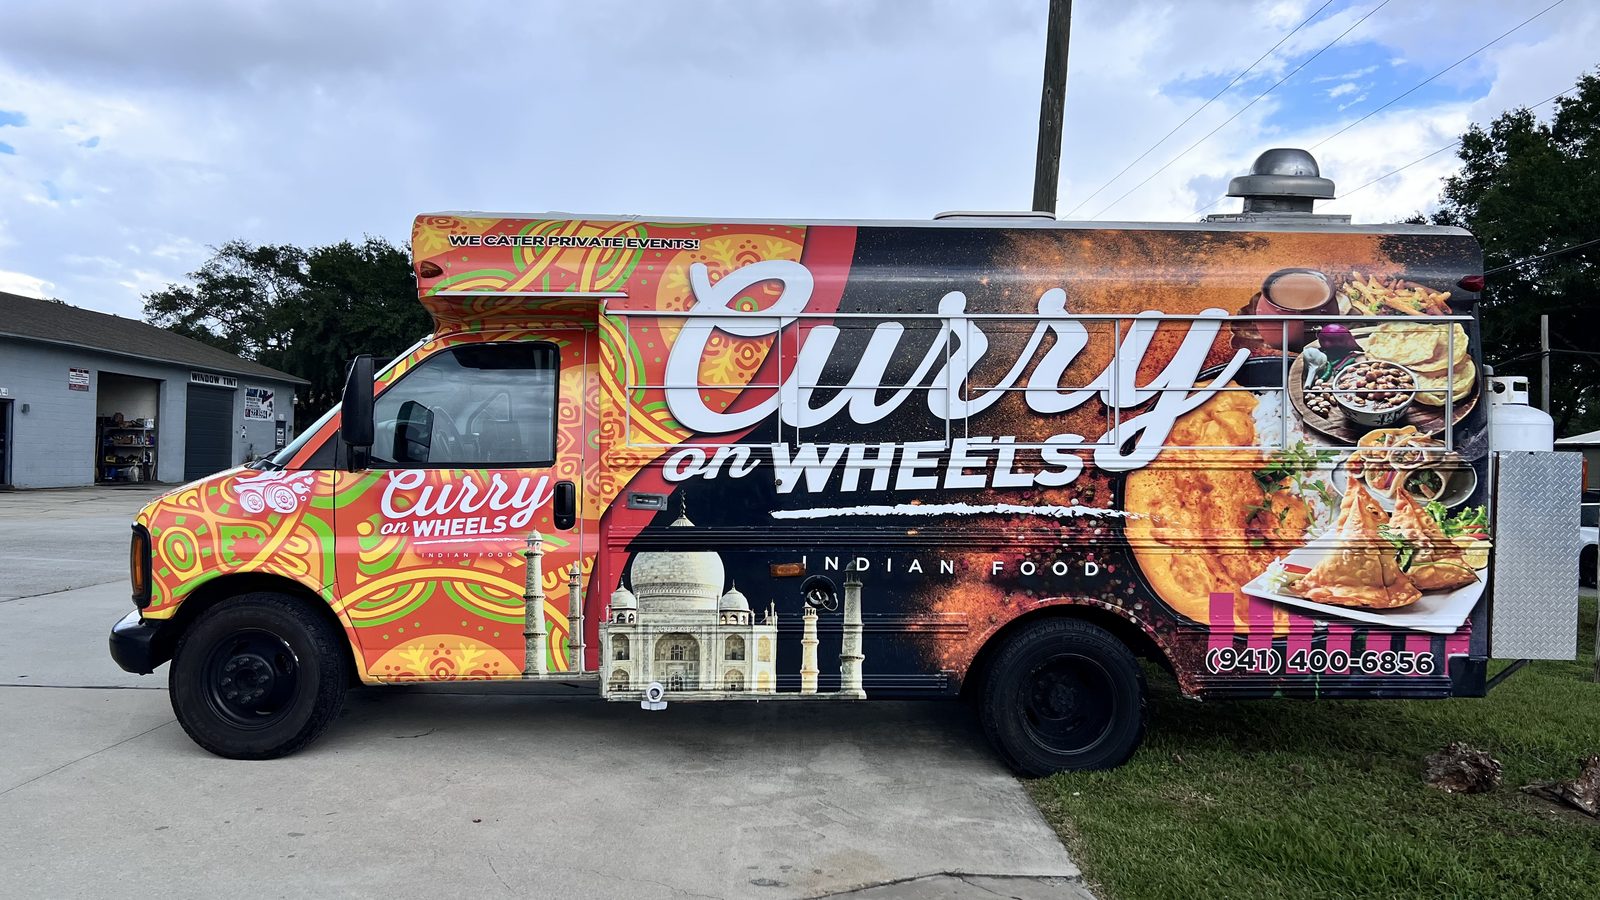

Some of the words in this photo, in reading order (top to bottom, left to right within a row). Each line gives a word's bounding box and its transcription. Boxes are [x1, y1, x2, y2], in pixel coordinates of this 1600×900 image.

[449, 235, 481, 246] WE
[483, 235, 545, 247] CATER
[548, 236, 623, 248] PRIVATE
[624, 237, 700, 250] EVENTS!
[664, 259, 1250, 472] Curry
[191, 371, 220, 385] WINDOW
[222, 376, 237, 387] TINT
[662, 445, 762, 482] on
[773, 432, 1084, 494] WHEELS
[380, 469, 555, 528] Curry
[380, 521, 410, 535] on
[412, 515, 508, 538] WHEELS
[802, 556, 954, 575] INDIAN
[992, 560, 1100, 577] FOOD
[1205, 647, 1282, 675] (941)
[1287, 649, 1435, 675] 400-6856
